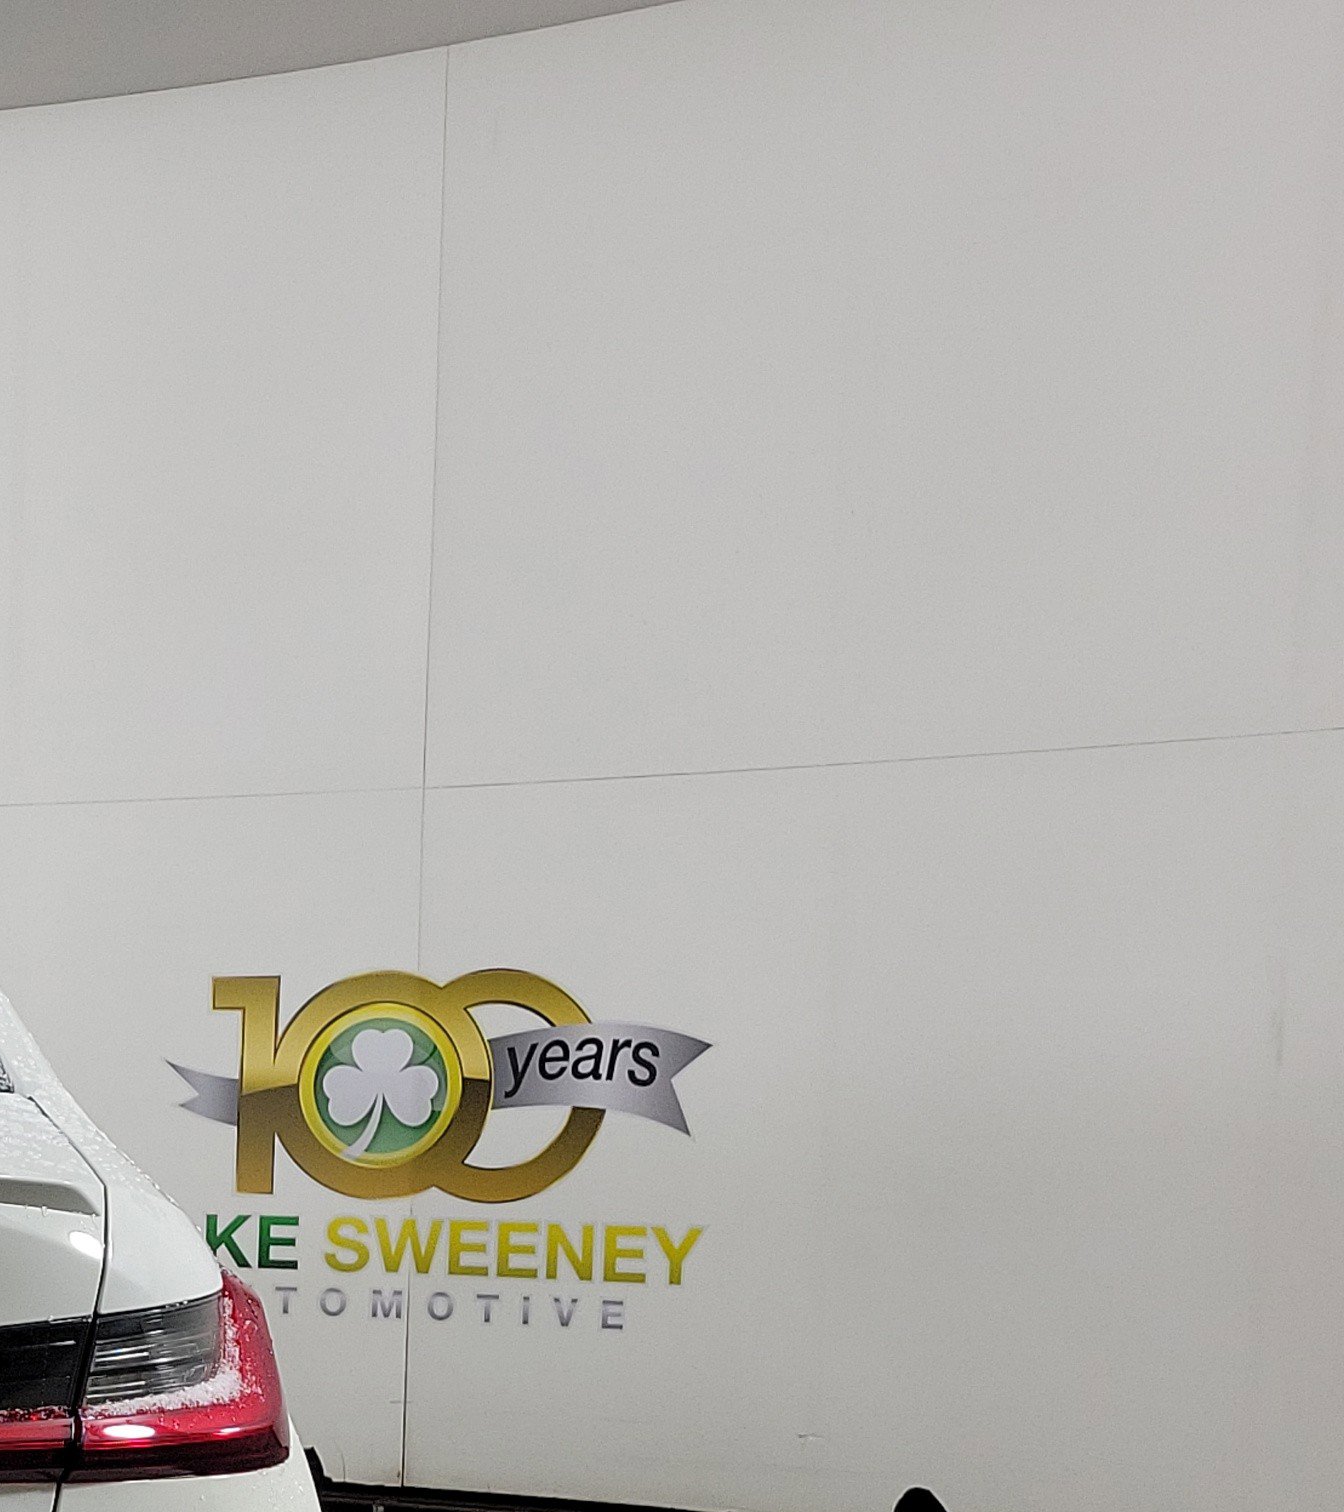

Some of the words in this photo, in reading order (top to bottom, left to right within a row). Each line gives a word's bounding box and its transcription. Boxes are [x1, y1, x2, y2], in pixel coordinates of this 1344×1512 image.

[212, 969, 606, 1204] 100
[503, 1036, 660, 1098] years
[205, 1213, 300, 1270] KE
[323, 1215, 703, 1286] SWEENEY
[274, 1286, 625, 1330] TOMOTIVE
